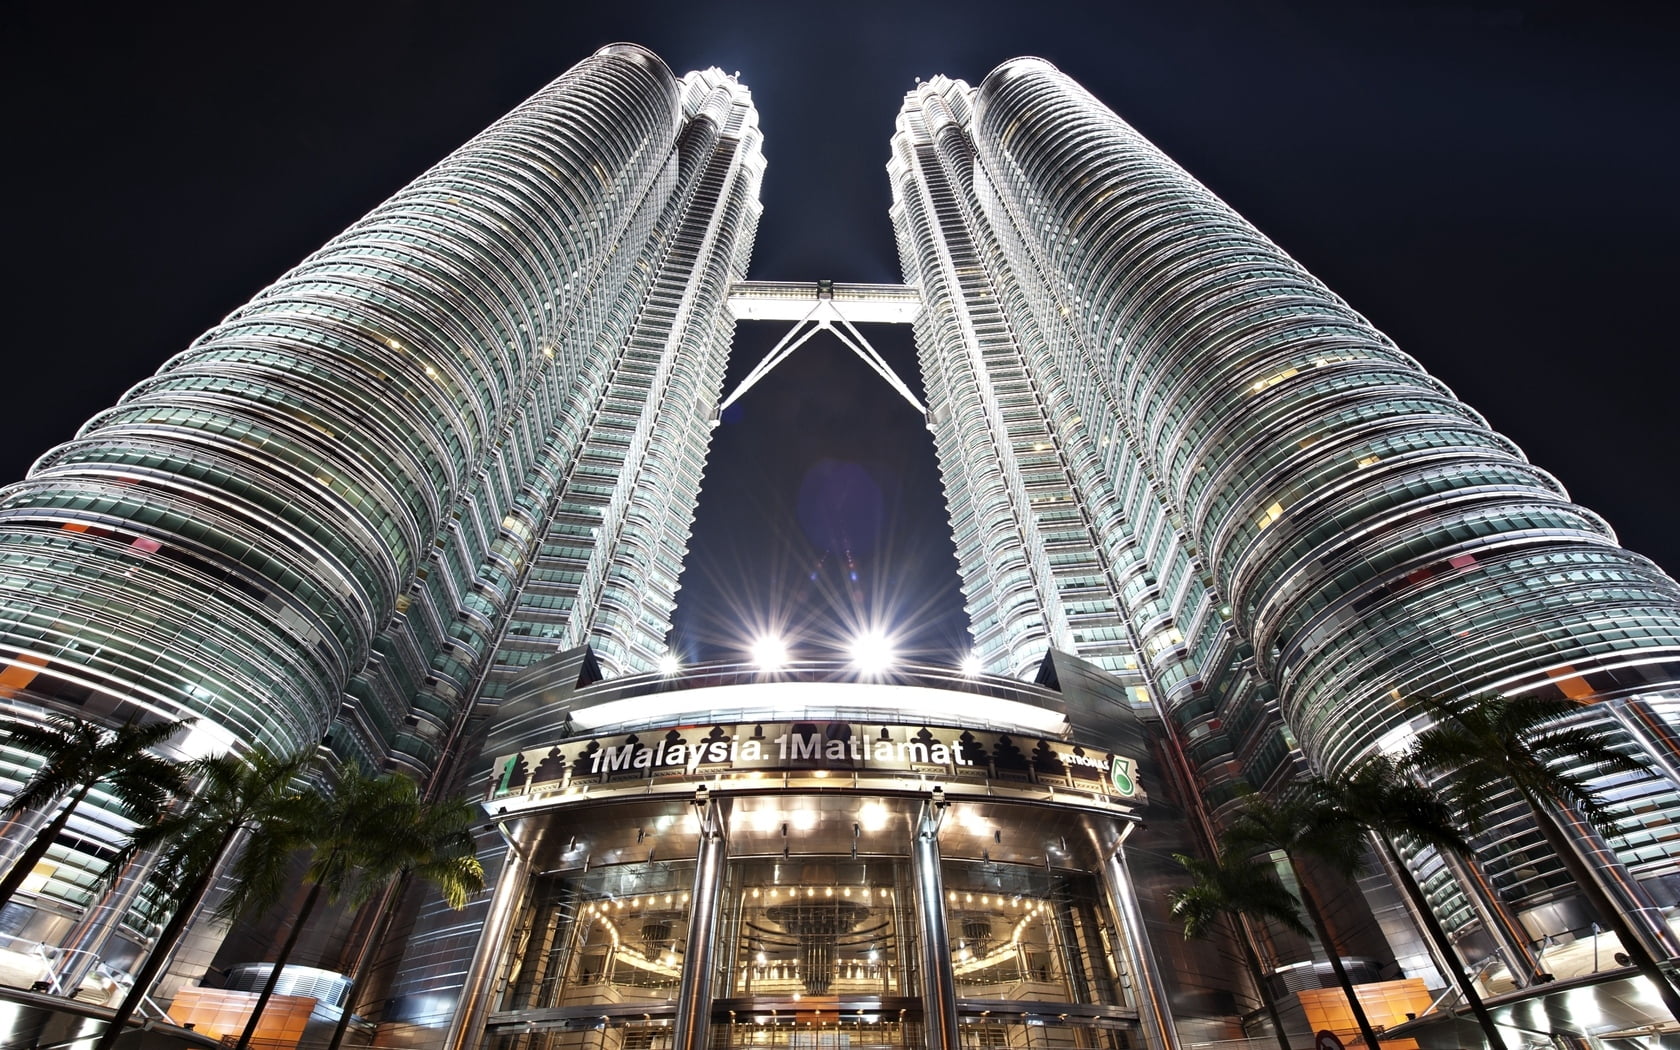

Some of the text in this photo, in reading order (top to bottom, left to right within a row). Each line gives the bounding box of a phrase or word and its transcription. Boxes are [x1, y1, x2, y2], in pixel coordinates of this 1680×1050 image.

[590, 733, 974, 774] 1Malaysia. 1Matlamat.
[1058, 752, 1110, 771] PETRONAS
[495, 754, 518, 795] 1
